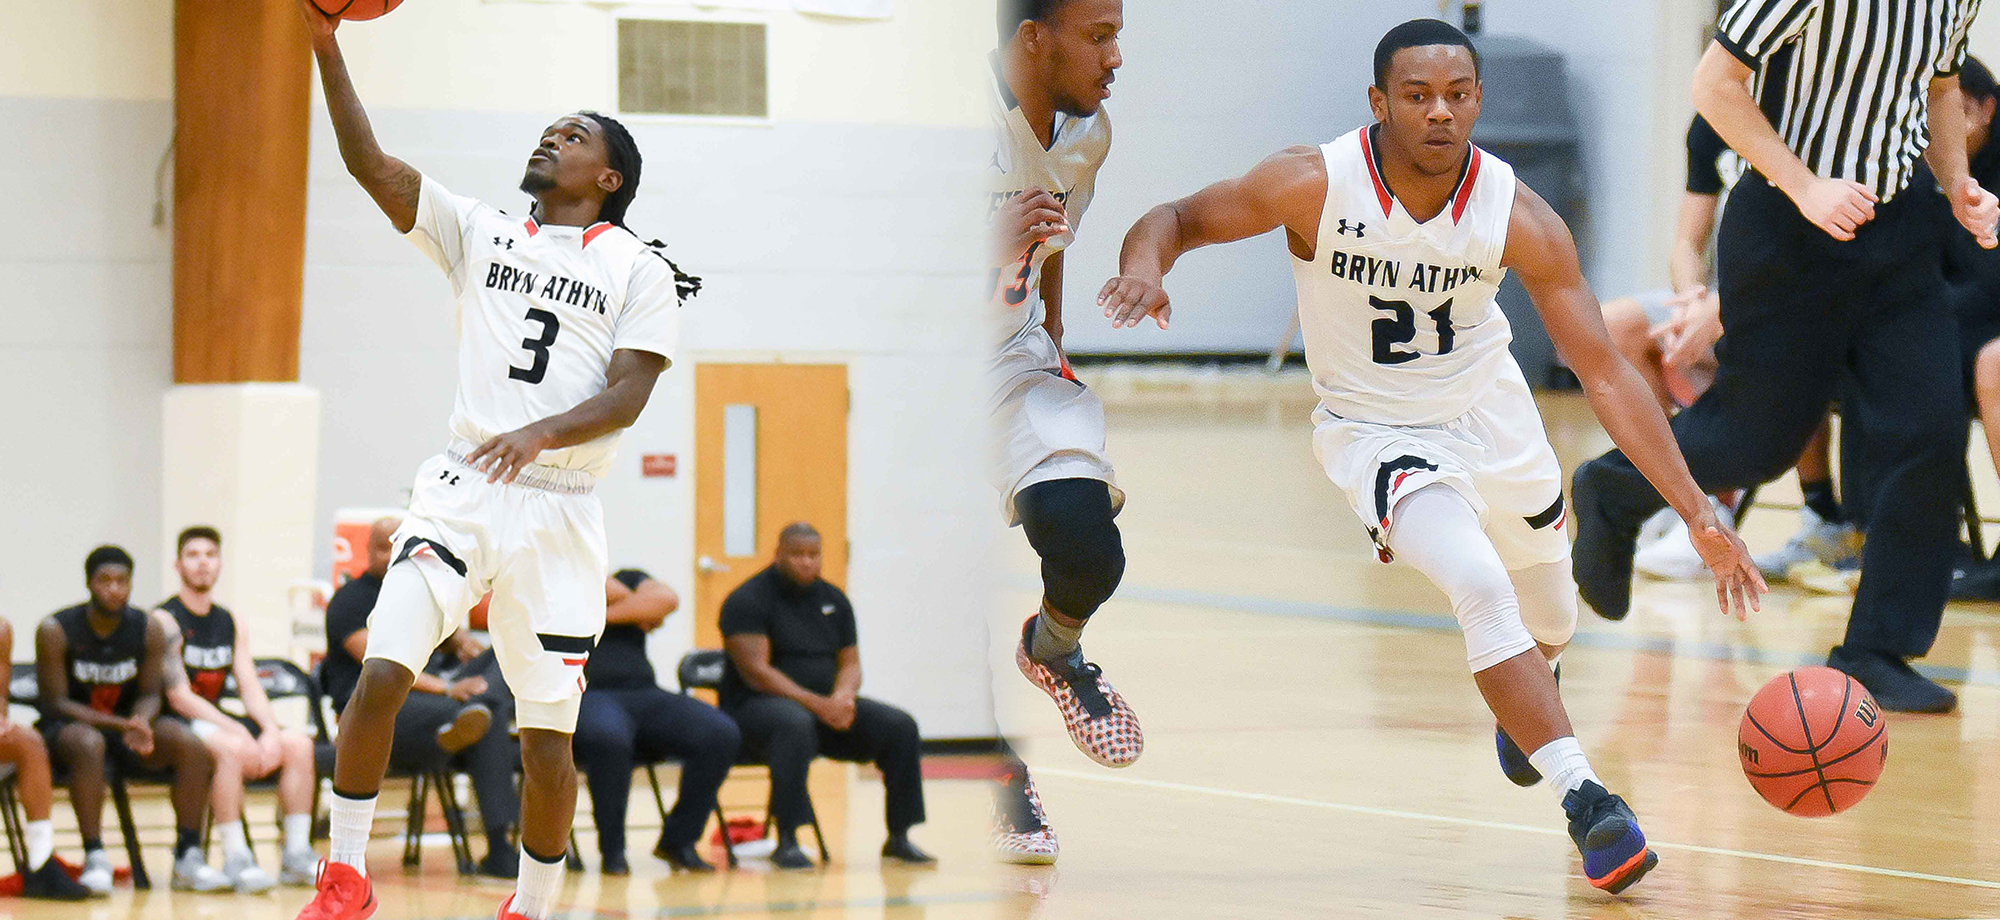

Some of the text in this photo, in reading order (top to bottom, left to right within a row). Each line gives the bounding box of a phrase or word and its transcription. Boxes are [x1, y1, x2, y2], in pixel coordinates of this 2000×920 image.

[485, 262, 608, 315] BRYN ATHYN
[1331, 250, 1401, 288] BRYN
[508, 307, 560, 385] 3
[1368, 294, 1457, 365] 21
